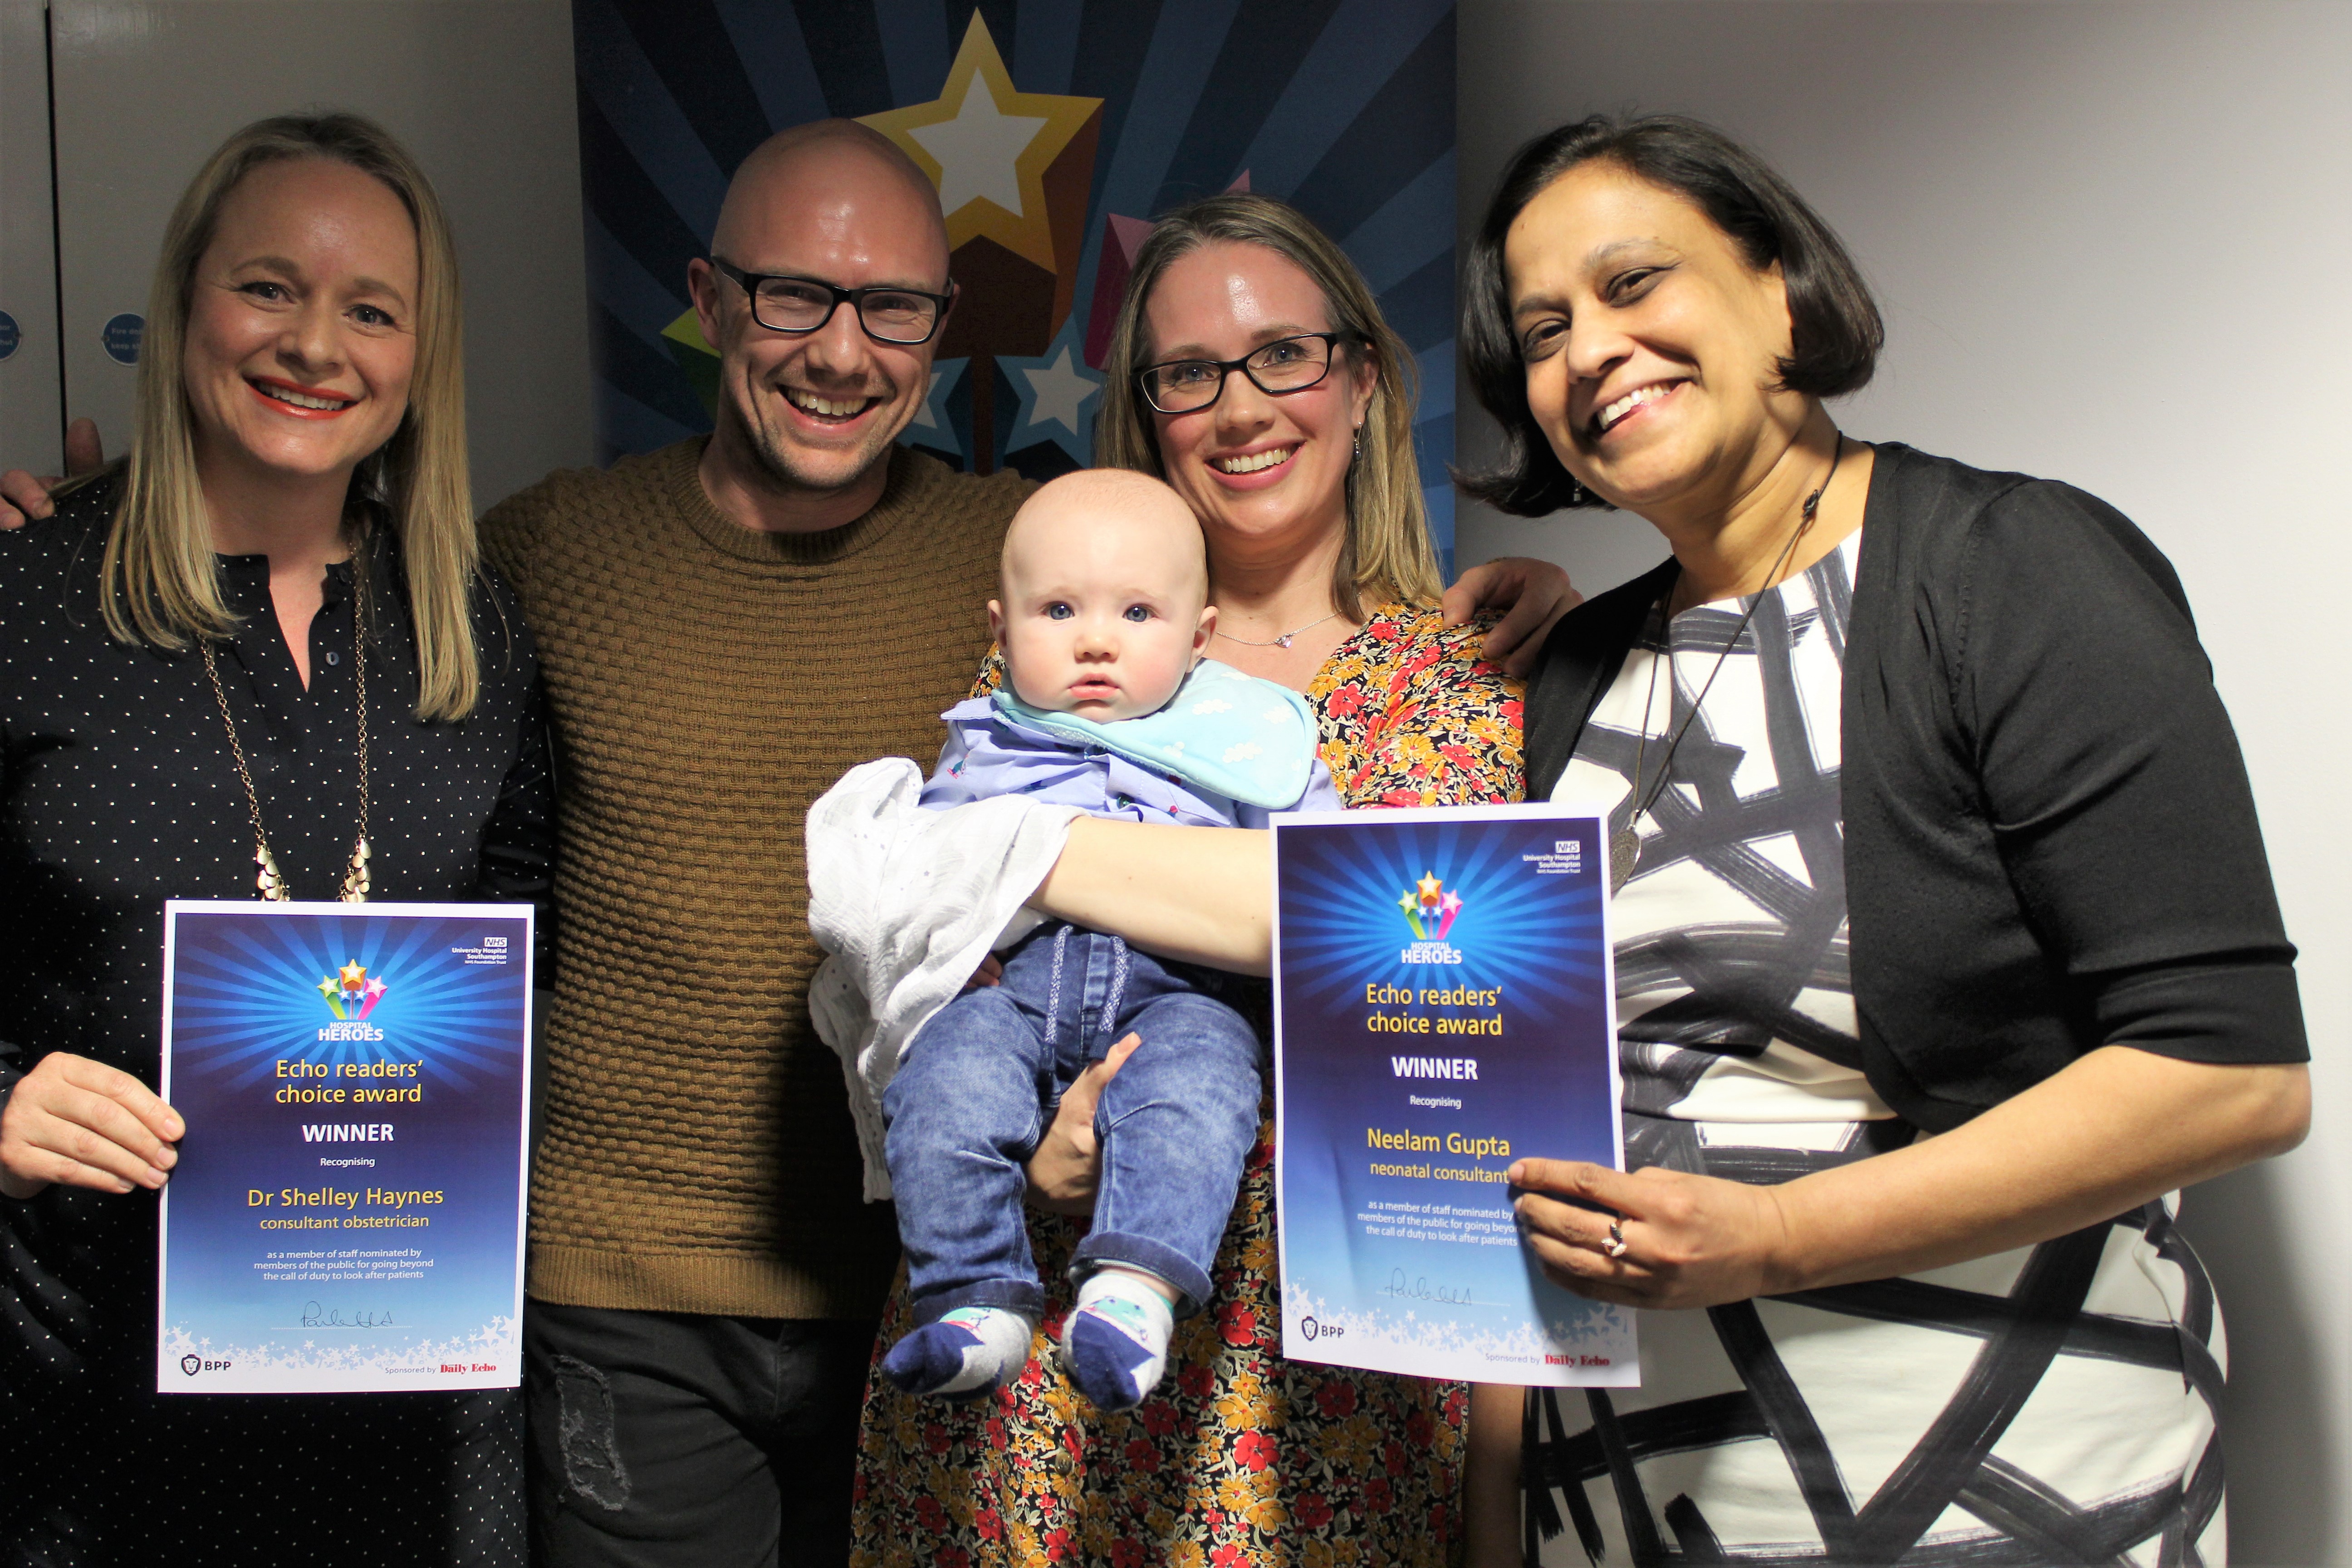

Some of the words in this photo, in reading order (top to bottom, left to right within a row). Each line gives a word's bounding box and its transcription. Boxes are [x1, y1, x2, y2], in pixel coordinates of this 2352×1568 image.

[1401, 950, 1462, 965] HEROES
[1367, 983, 1413, 1004] Echo
[1419, 985, 1501, 1007] readers'
[1367, 1010, 1430, 1033] choice
[1436, 1012, 1502, 1035] award
[318, 1029, 384, 1041] HEROES
[276, 1058, 329, 1078] Echo
[336, 1058, 423, 1078] readers'
[1392, 1057, 1478, 1080] WINNER
[275, 1084, 346, 1103] choice
[353, 1084, 421, 1102] award
[1410, 1095, 1461, 1110] Recognising
[302, 1124, 395, 1142] WINNER
[1367, 1128, 1441, 1152] Neelam
[1446, 1132, 1510, 1159] Gupta
[320, 1157, 375, 1168] Recognising
[1370, 1163, 1430, 1178] neonatal
[1434, 1166, 1510, 1184] consultant
[248, 1189, 274, 1206] Dr
[281, 1188, 359, 1210] Shelley
[367, 1187, 444, 1209] Haynes
[1386, 1203, 1419, 1212] member
[1422, 1204, 1431, 1212] of
[1432, 1205, 1450, 1215] staff
[1452, 1207, 1500, 1219] nominated
[1502, 1210, 1514, 1221] by
[260, 1215, 338, 1230] consultant
[343, 1215, 430, 1229] obstetrician
[1357, 1213, 1395, 1224] members
[1397, 1215, 1406, 1225] of
[1407, 1216, 1421, 1225] the
[1423, 1217, 1449, 1228] public
[1450, 1220, 1462, 1229] for
[1465, 1221, 1490, 1233] going
[1367, 1226, 1380, 1235] the
[1382, 1227, 1395, 1236] call
[1396, 1228, 1406, 1237] of
[1407, 1229, 1426, 1241] duty
[1439, 1231, 1457, 1241] look
[1459, 1234, 1479, 1243] after
[1481, 1236, 1517, 1247] patients
[338, 1250, 358, 1258] staff
[360, 1249, 408, 1258] nominated
[411, 1249, 421, 1258] by
[328, 1261, 355, 1270] public
[372, 1260, 397, 1269] going
[400, 1259, 433, 1269] beyond
[309, 1272, 330, 1281] duty
[344, 1271, 363, 1279] look
[388, 1271, 423, 1280] patients
[1321, 1326, 1344, 1339] BPP
[205, 1361, 231, 1370] BPP
[440, 1364, 468, 1374] Daily
[471, 1363, 496, 1372] Echo
[1485, 1354, 1528, 1363] Sponsored
[1545, 1355, 1576, 1368] Daily
[1581, 1355, 1609, 1366] Echo
